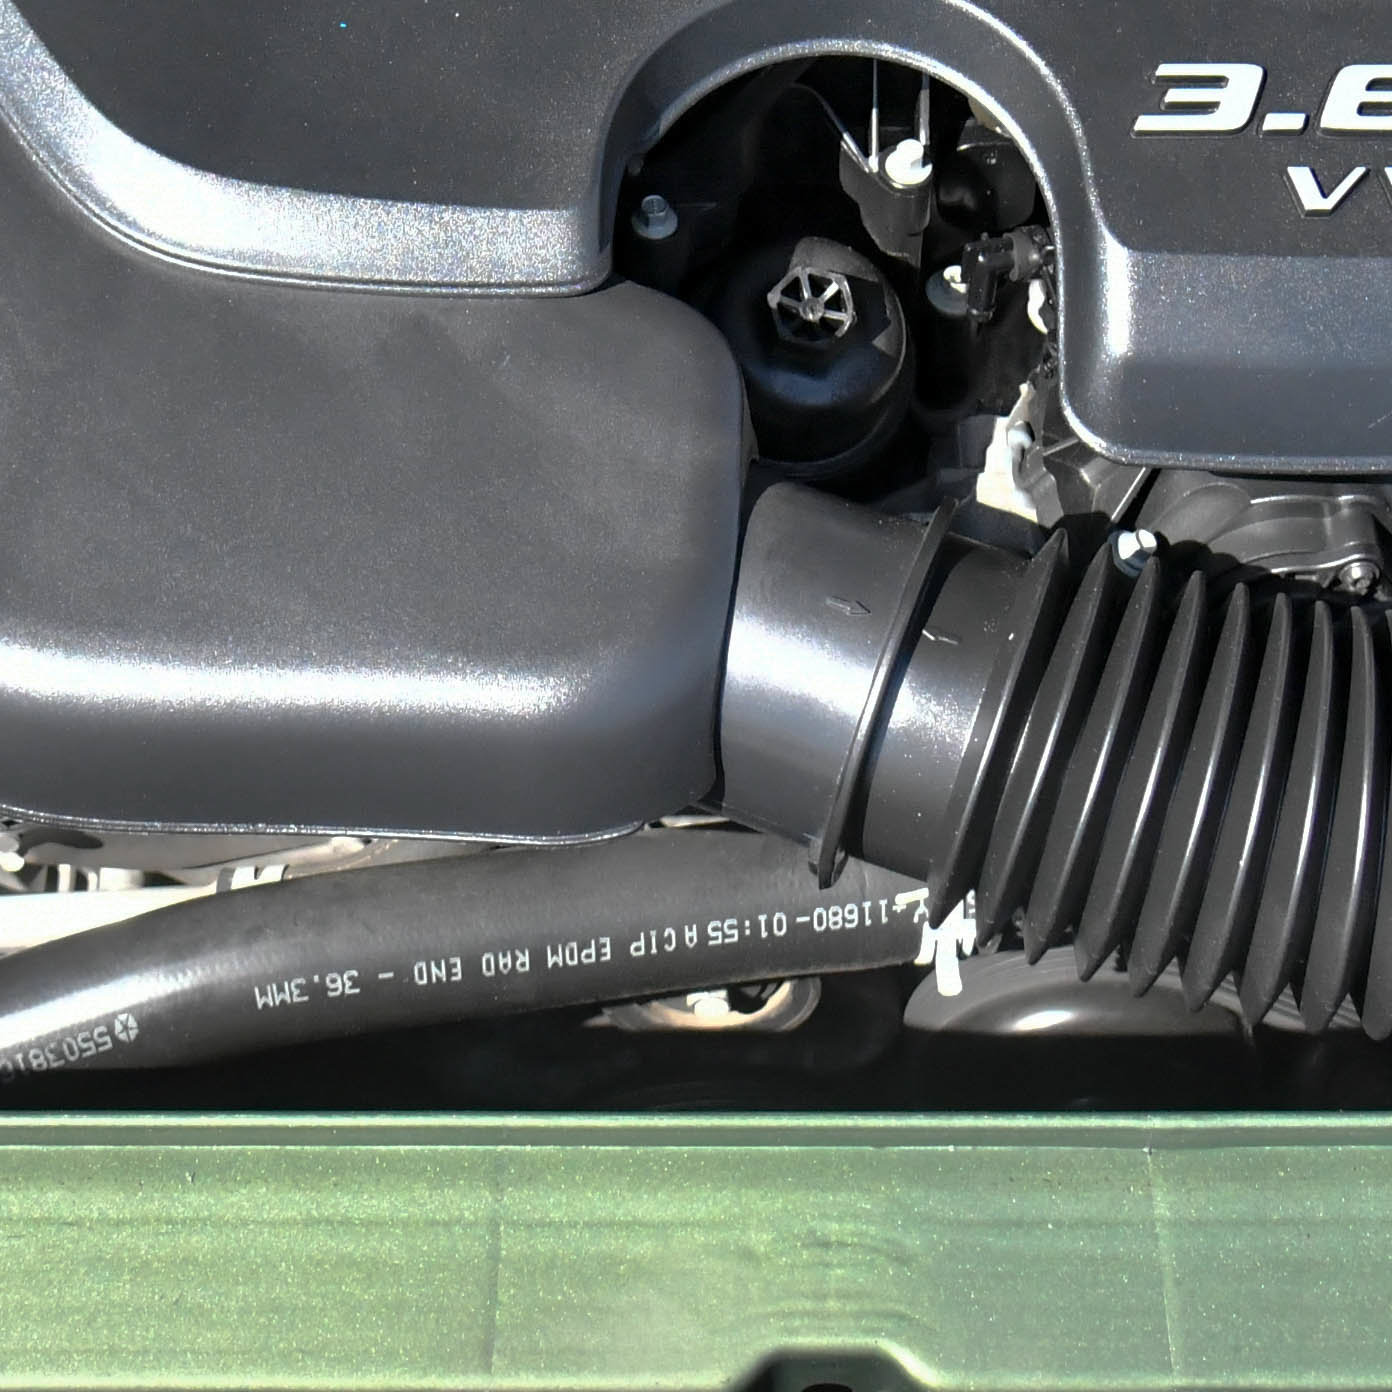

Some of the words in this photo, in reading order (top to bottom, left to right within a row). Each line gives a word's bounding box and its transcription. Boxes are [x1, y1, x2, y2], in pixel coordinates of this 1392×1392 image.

[482, 948, 531, 977] RAD
[546, 934, 611, 969] EPDM
[413, 956, 463, 986] END
[254, 969, 361, 1010] 36.3MM
